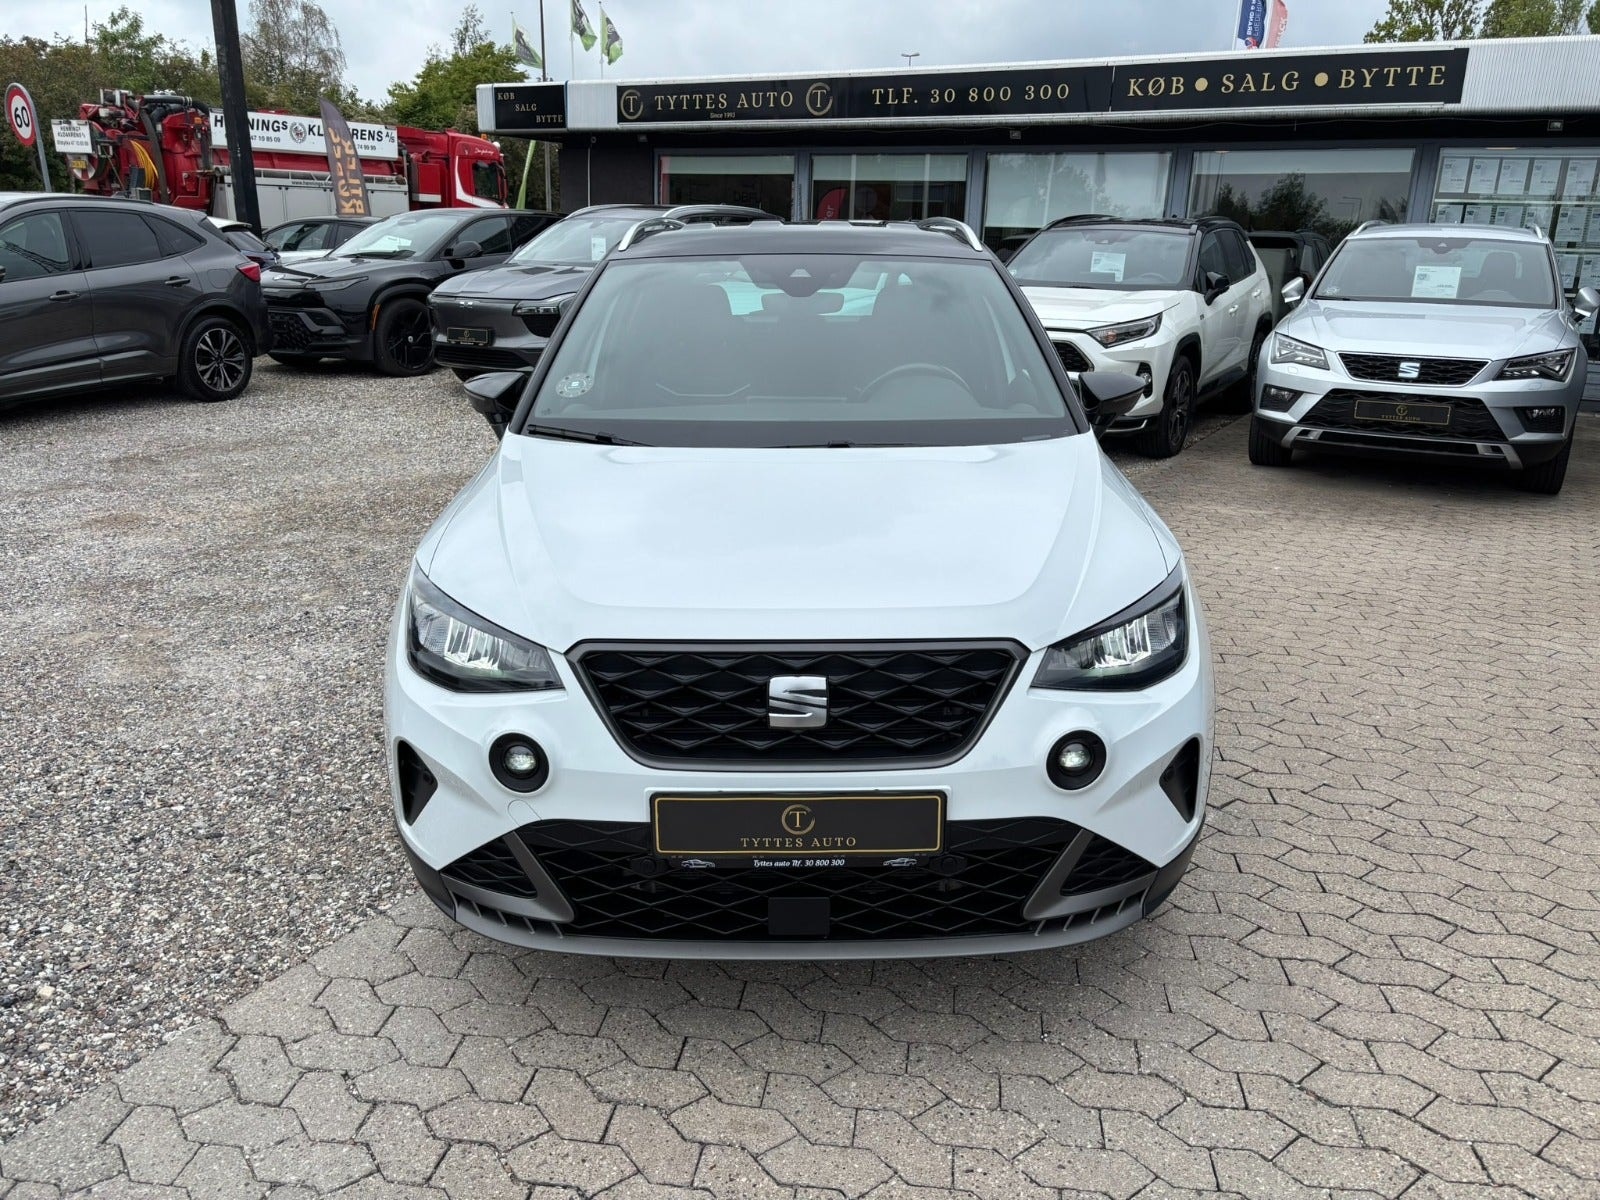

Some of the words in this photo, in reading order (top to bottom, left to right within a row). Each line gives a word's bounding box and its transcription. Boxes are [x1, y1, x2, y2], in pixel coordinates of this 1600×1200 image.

[1127, 75, 1185, 96] KØB
[1220, 71, 1300, 93] SALG
[1338, 65, 1447, 89] BYTTE
[497, 92, 515, 100] KØB
[654, 93, 728, 111] TYTTES
[736, 90, 794, 109] AUTO
[872, 87, 918, 105] TLF.
[930, 88, 956, 104] 30
[968, 86, 1012, 103] 800
[1024, 83, 1070, 101] 300
[515, 103, 537, 112] SALG
[14, 105, 30, 129] 60
[536, 114, 563, 123] BYTTE
[214, 114, 288, 133] HNINGS
[308, 123, 383, 142] KLRENS
[740, 837, 803, 848] TYTTES
[811, 836, 857, 847] AUTO
[753, 859, 773, 868] Tyttes
[804, 859, 814, 867] 30
[815, 859, 830, 867] 800
[830, 859, 845, 867] 300
